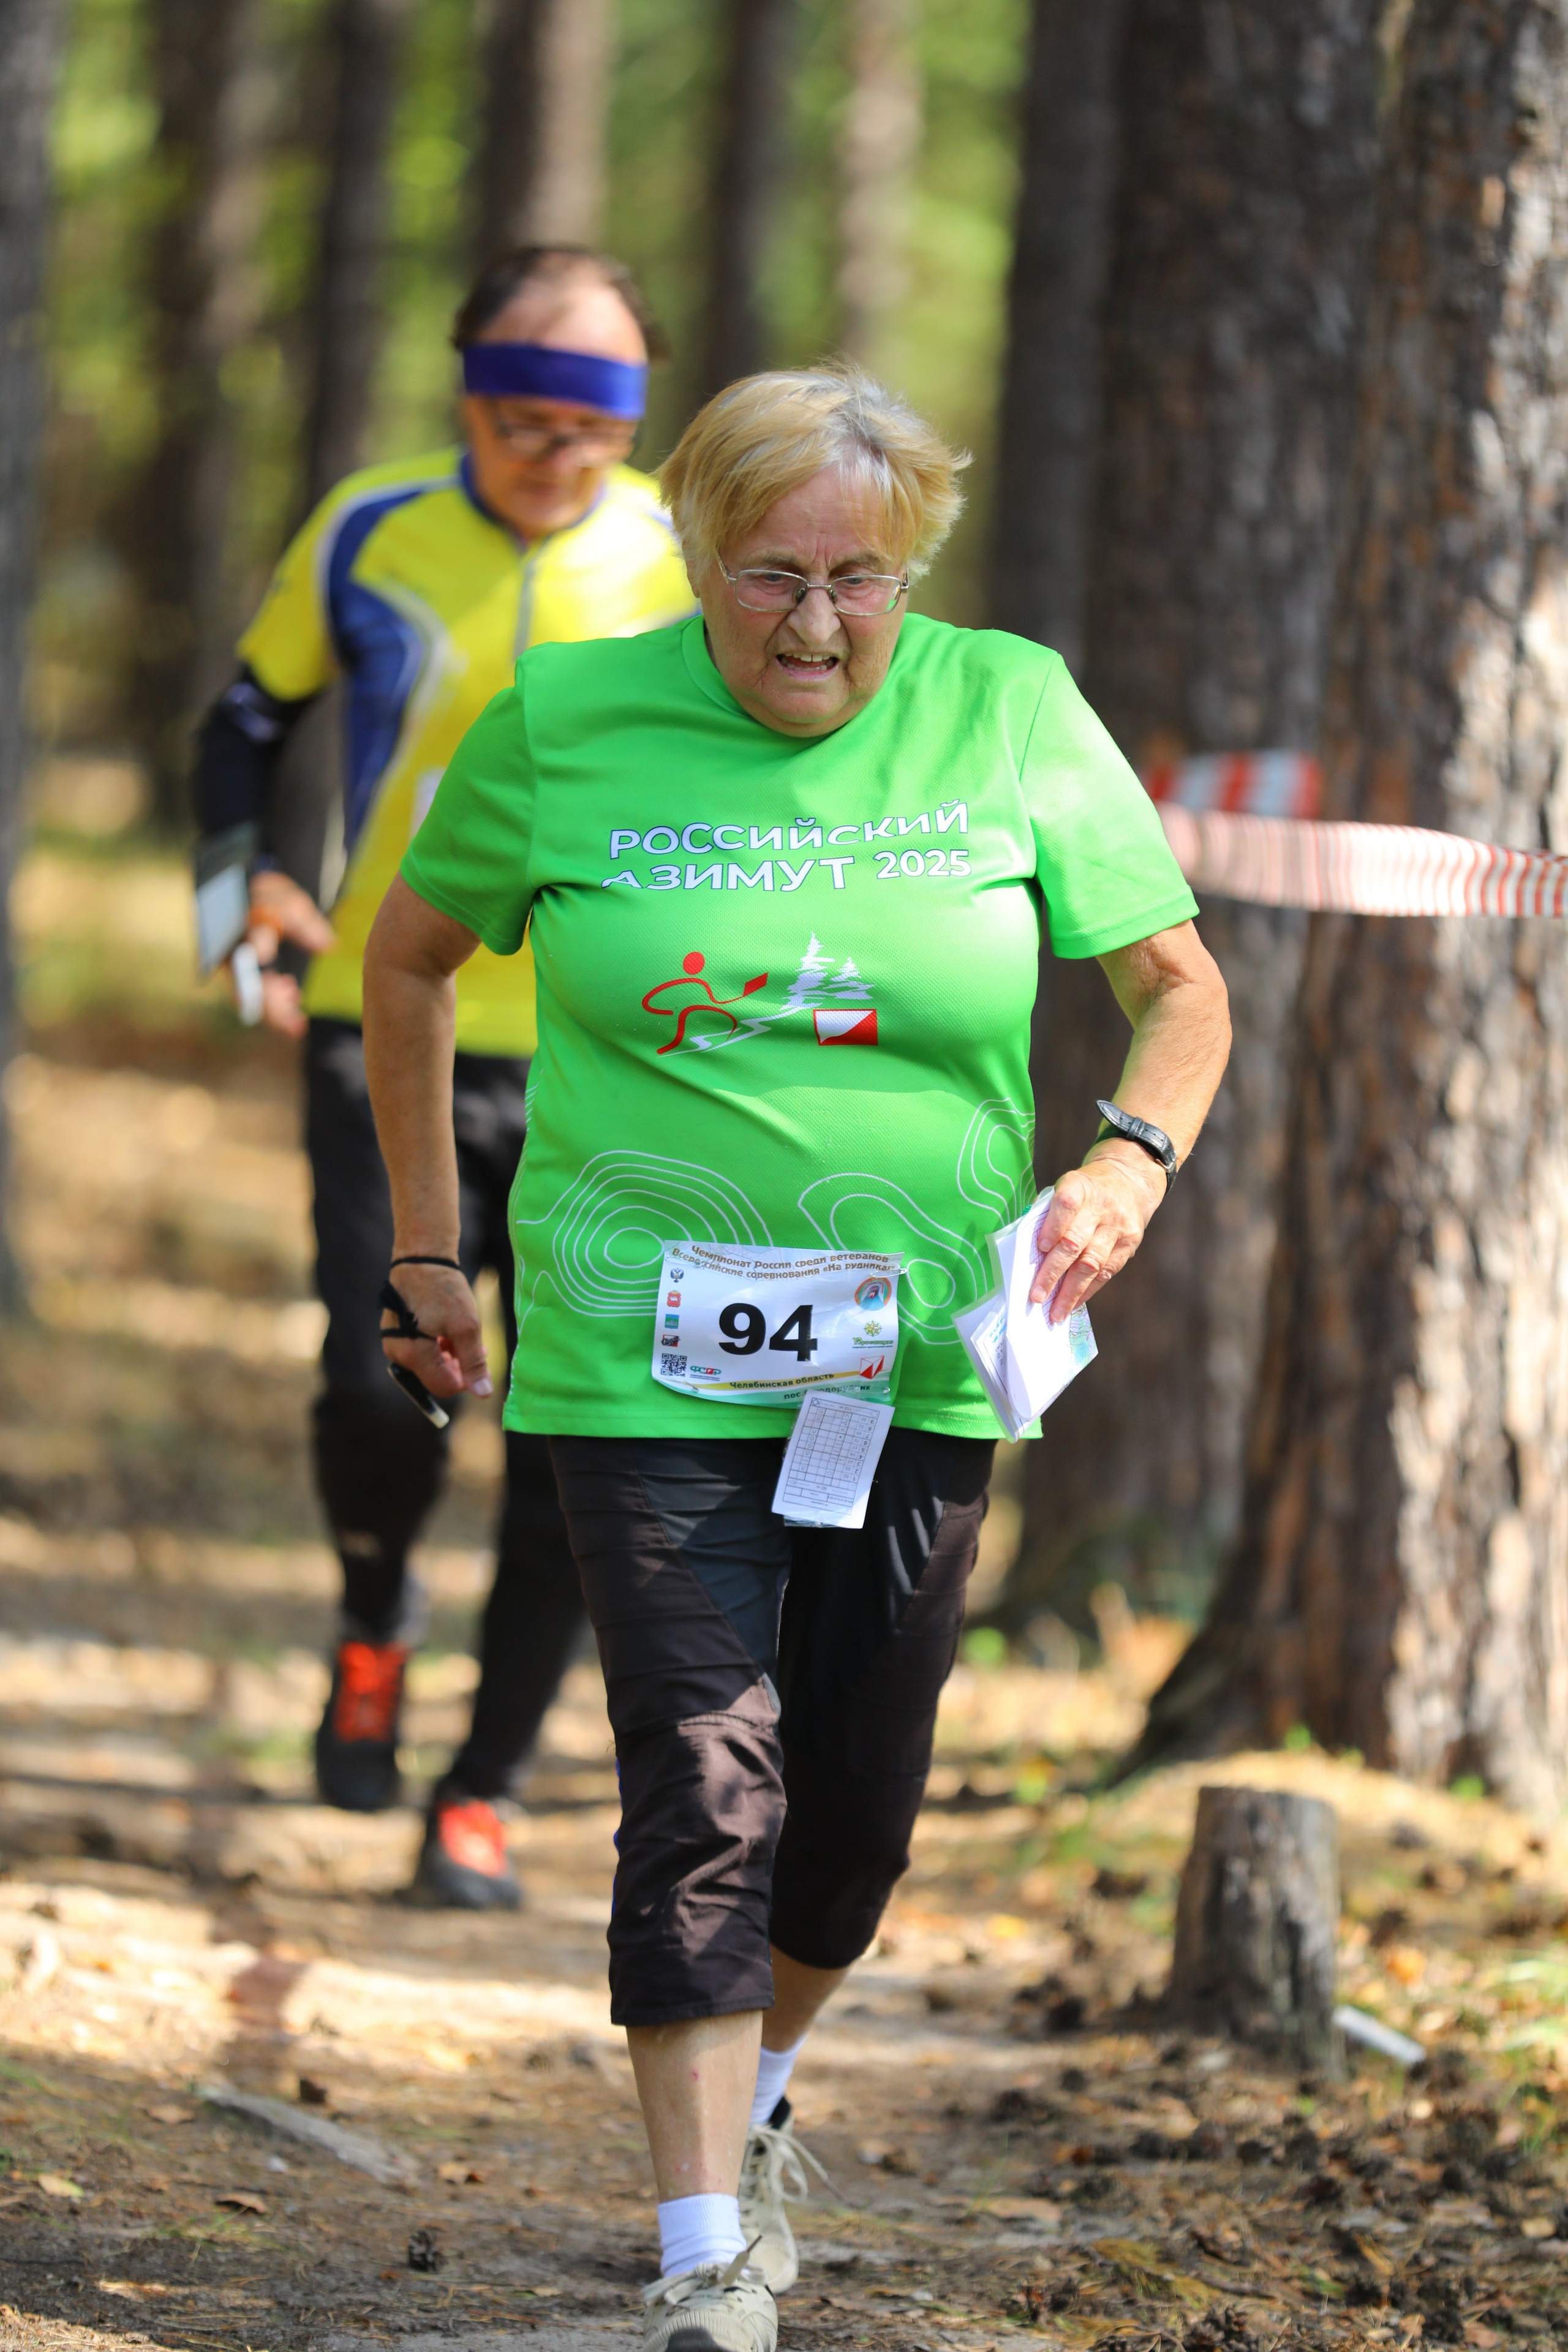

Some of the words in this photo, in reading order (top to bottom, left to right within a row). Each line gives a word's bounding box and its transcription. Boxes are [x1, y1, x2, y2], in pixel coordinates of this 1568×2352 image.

[609, 798, 968, 859] РОССИЙСКИЙ
[601, 855, 854, 892] АЗИМУТ
[873, 848, 971, 880] 2025
[692, 1245, 752, 1268] Чемпионат
[755, 1261, 791, 1270] России
[795, 1257, 826, 1268] среди
[830, 1253, 888, 1263] ветеранов
[746, 1267, 820, 1280] соревнования
[823, 1263, 842, 1273] «На
[718, 1303, 818, 1362] 94
[730, 1379, 793, 1389] Челябинская
[796, 1373, 835, 1385] область
